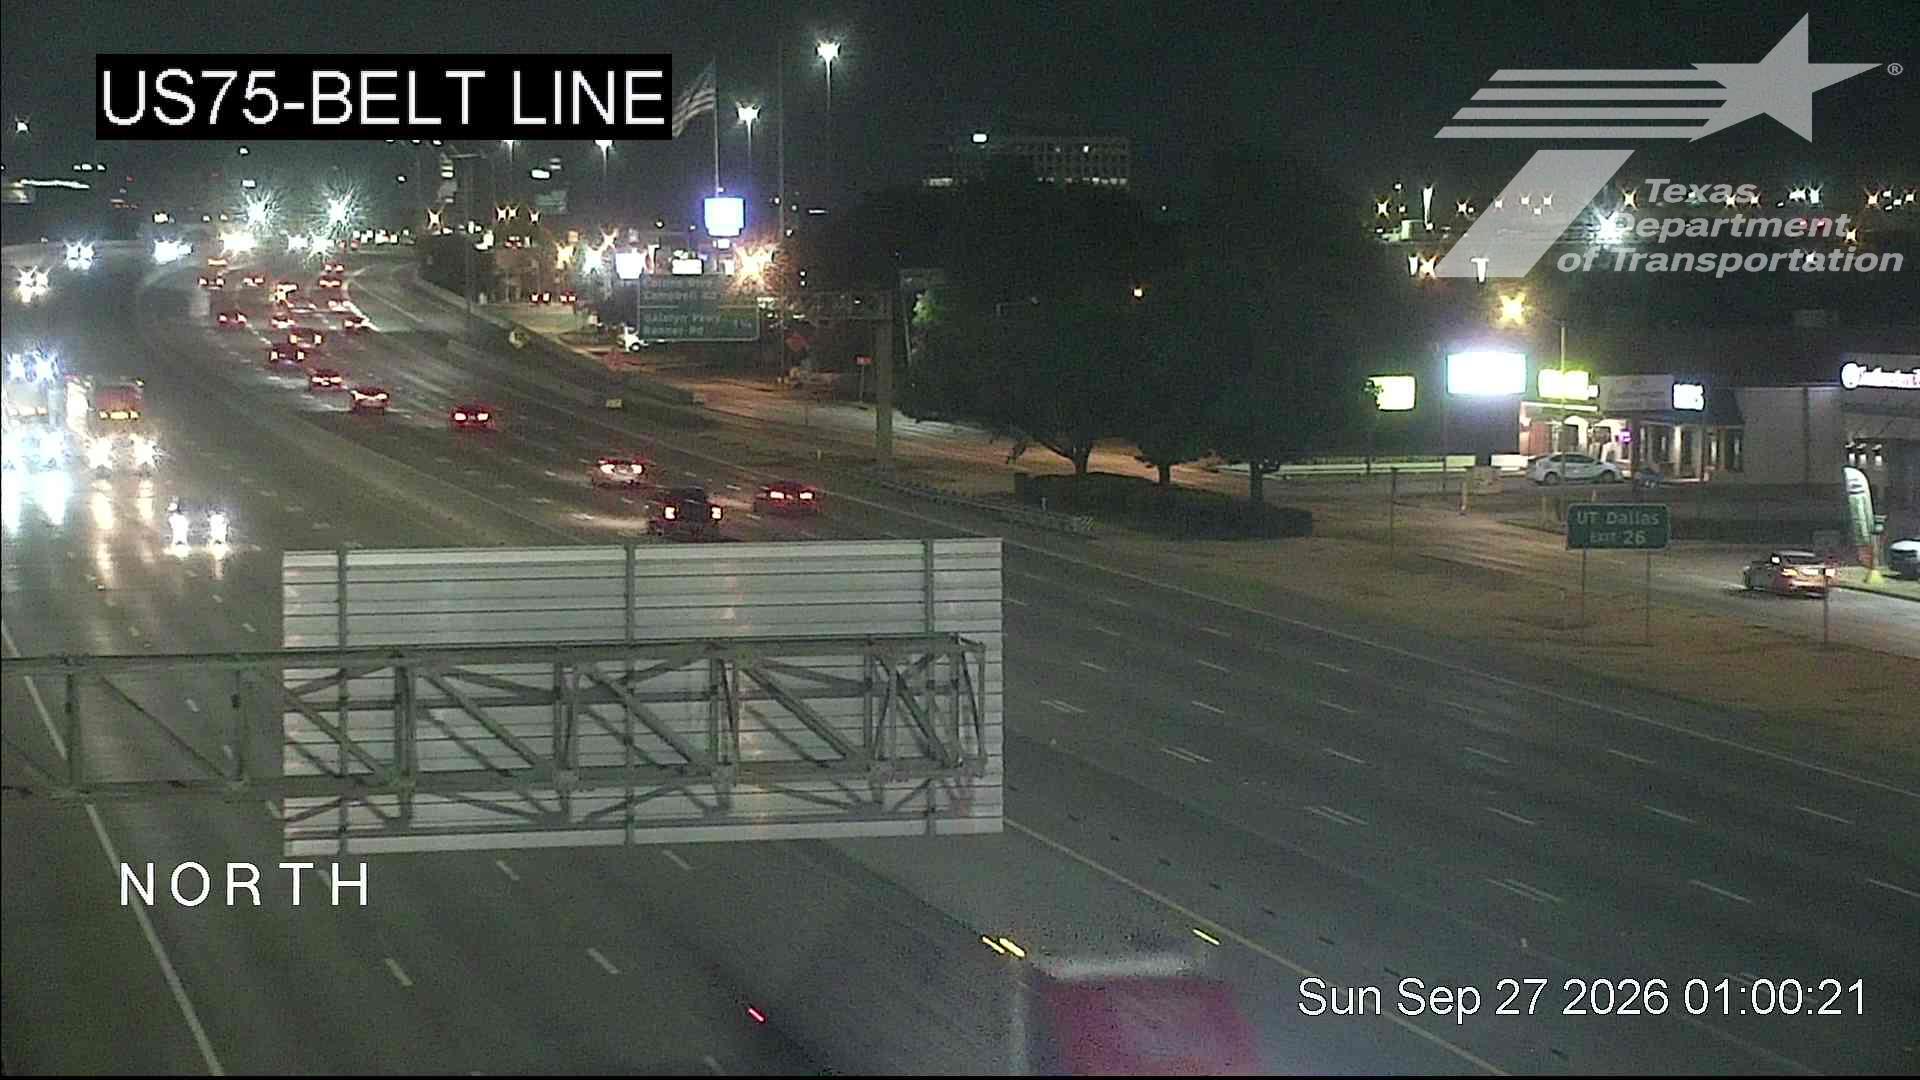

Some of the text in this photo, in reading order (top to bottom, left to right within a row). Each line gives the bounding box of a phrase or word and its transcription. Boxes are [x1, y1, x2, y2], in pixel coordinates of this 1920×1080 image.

[1576, 510, 1660, 525] UT Dallas
[1623, 530, 1646, 545] 26
